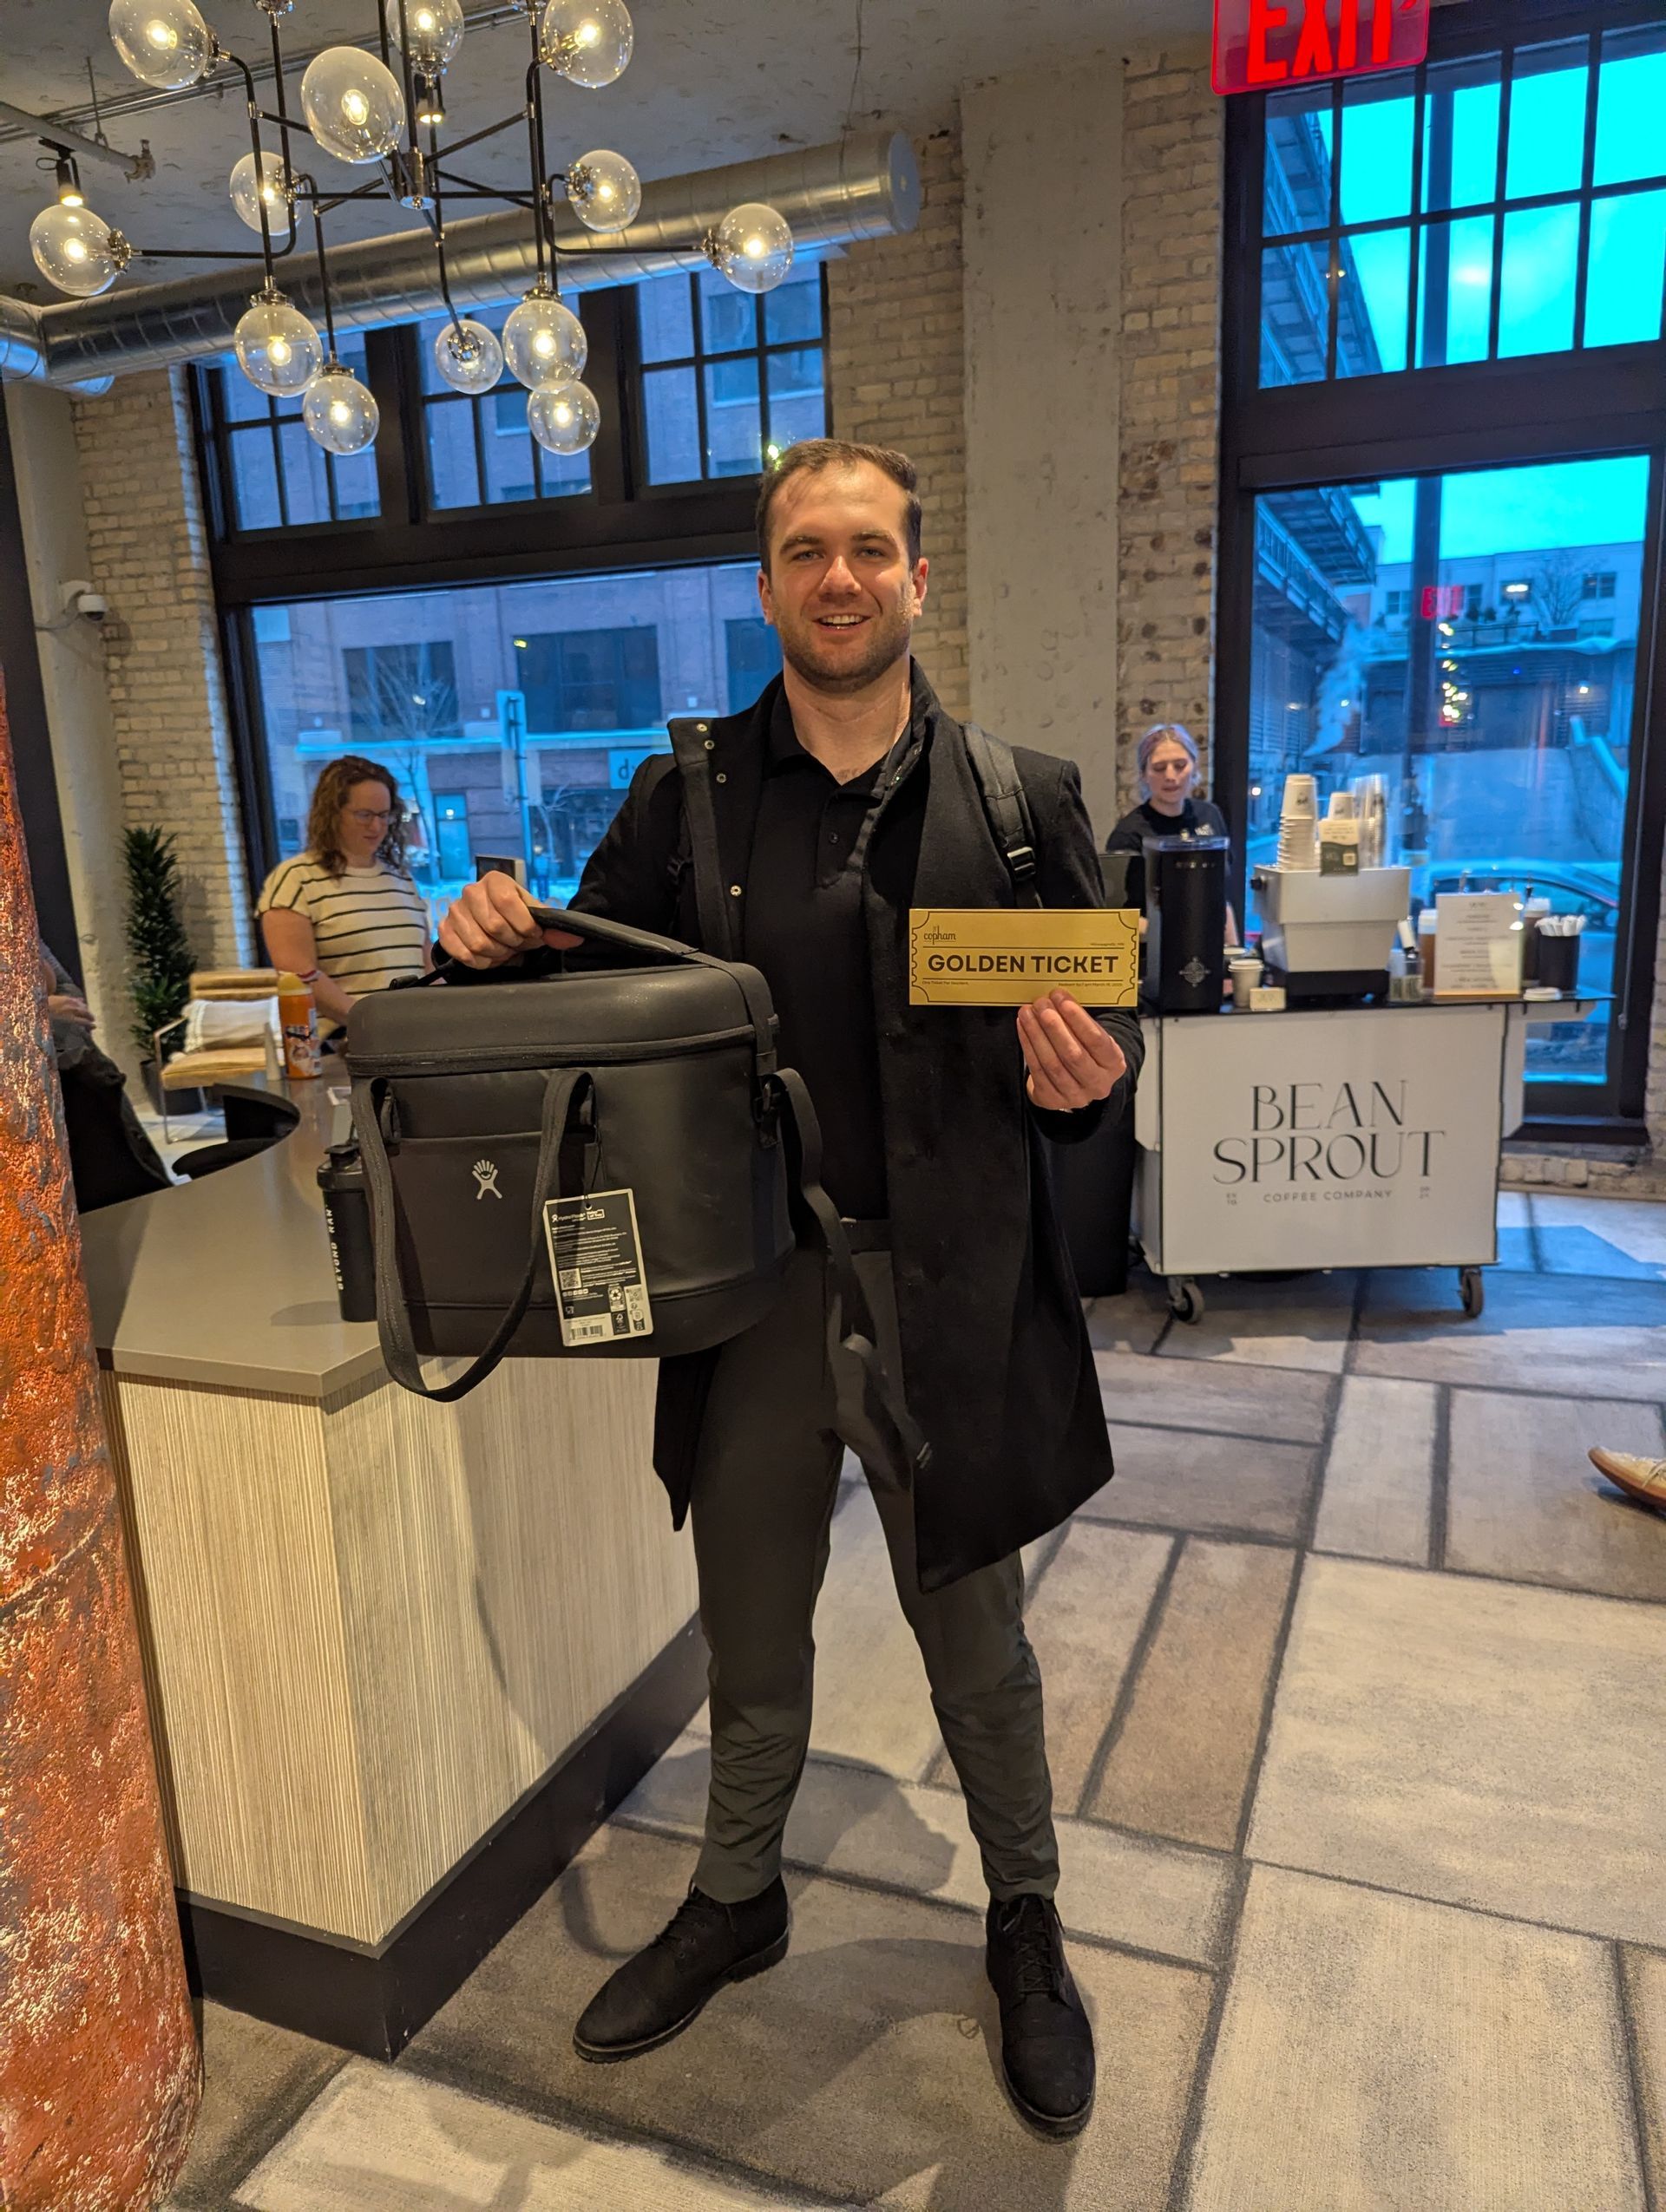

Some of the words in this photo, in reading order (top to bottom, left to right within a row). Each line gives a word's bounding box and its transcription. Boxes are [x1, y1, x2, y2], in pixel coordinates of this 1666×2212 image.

[923, 925, 956, 945] copham
[928, 954, 1025, 972] GOLDEN
[1031, 956, 1118, 973] TICKET
[1250, 1079, 1407, 1132] BEAN
[1212, 1129, 1446, 1185] SPROUT
[1263, 1192, 1318, 1203] COFFEE
[1323, 1189, 1393, 1201] COMPANY
[330, 1241, 344, 1291] BEYOND
